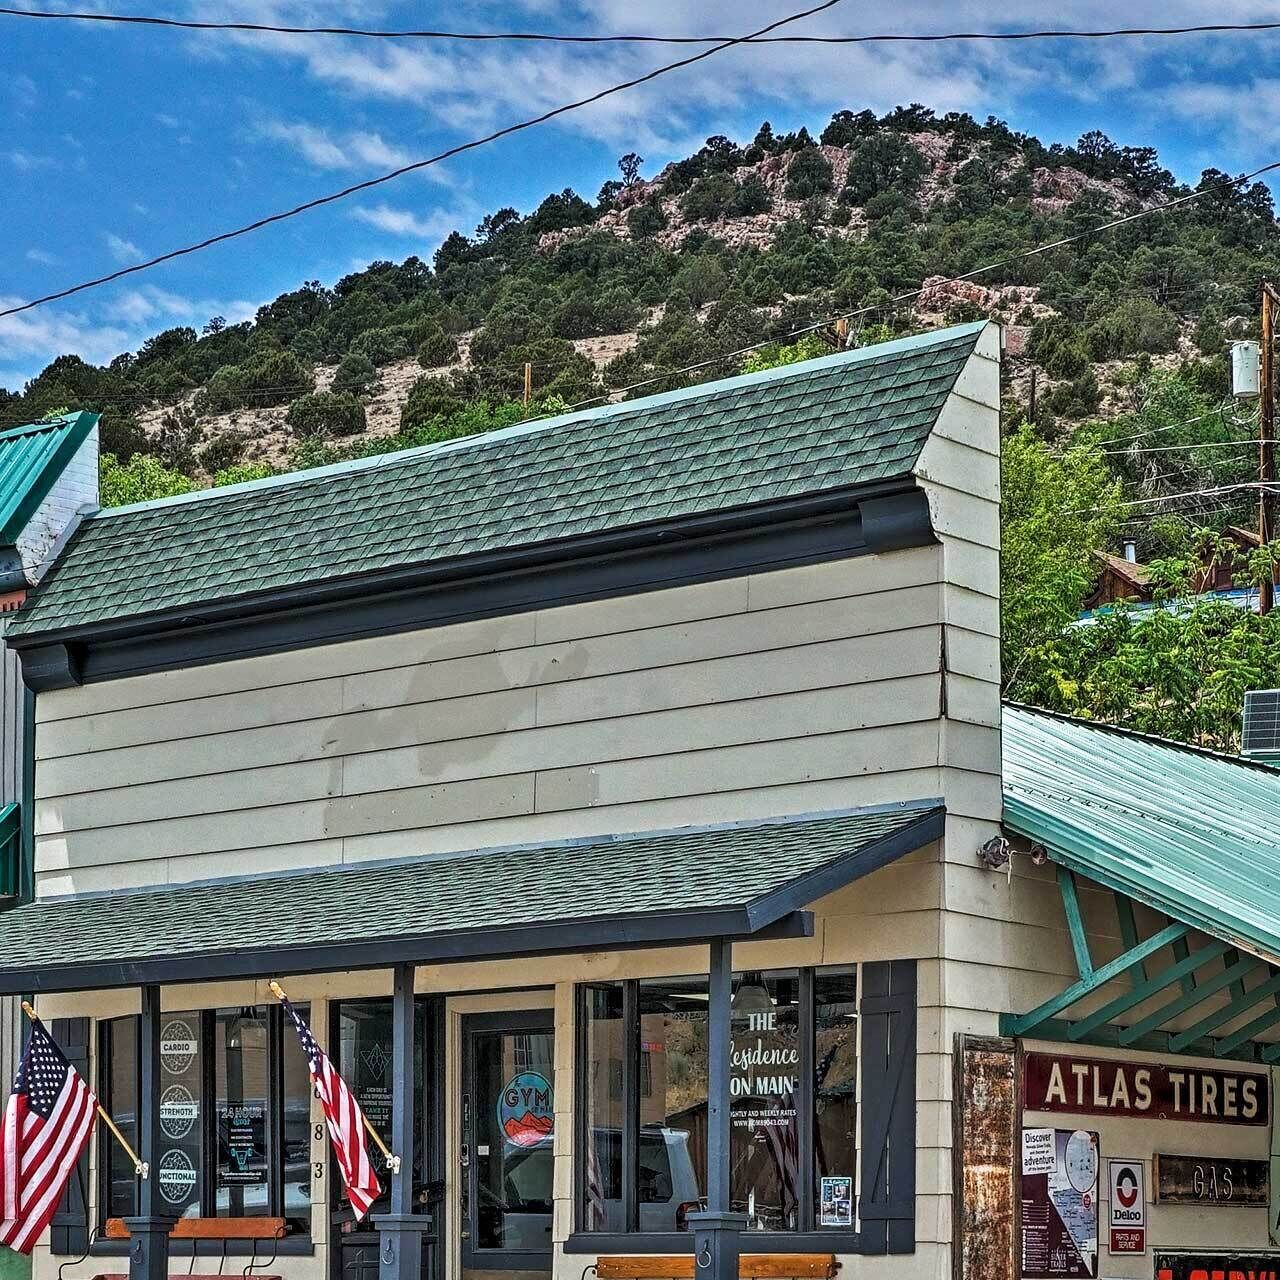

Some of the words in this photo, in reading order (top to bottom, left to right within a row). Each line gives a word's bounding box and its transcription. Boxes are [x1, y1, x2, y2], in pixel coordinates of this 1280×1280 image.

[747, 1012, 777, 1031] THE
[163, 1042, 190, 1052] CARDIO
[730, 1077, 751, 1096] ON
[756, 1075, 794, 1095] MAIN
[1044, 1061, 1152, 1110] ATLAS
[1168, 1071, 1258, 1119] TIRES
[505, 1087, 550, 1108] GYM
[160, 1107, 193, 1116] STRENGTH
[235, 1106, 262, 1119] HOUR
[748, 1109, 760, 1117] AND
[760, 1108, 780, 1117] WEEKLY
[780, 1108, 797, 1117] RATES
[1025, 1132, 1052, 1144] Discover
[1023, 1155, 1055, 1166] adventure
[1193, 1165, 1233, 1200] GAS
[1113, 1209, 1141, 1221] Delco
[1129, 1233, 1141, 1241] AND
[1118, 1240, 1136, 1249] SERVICE
